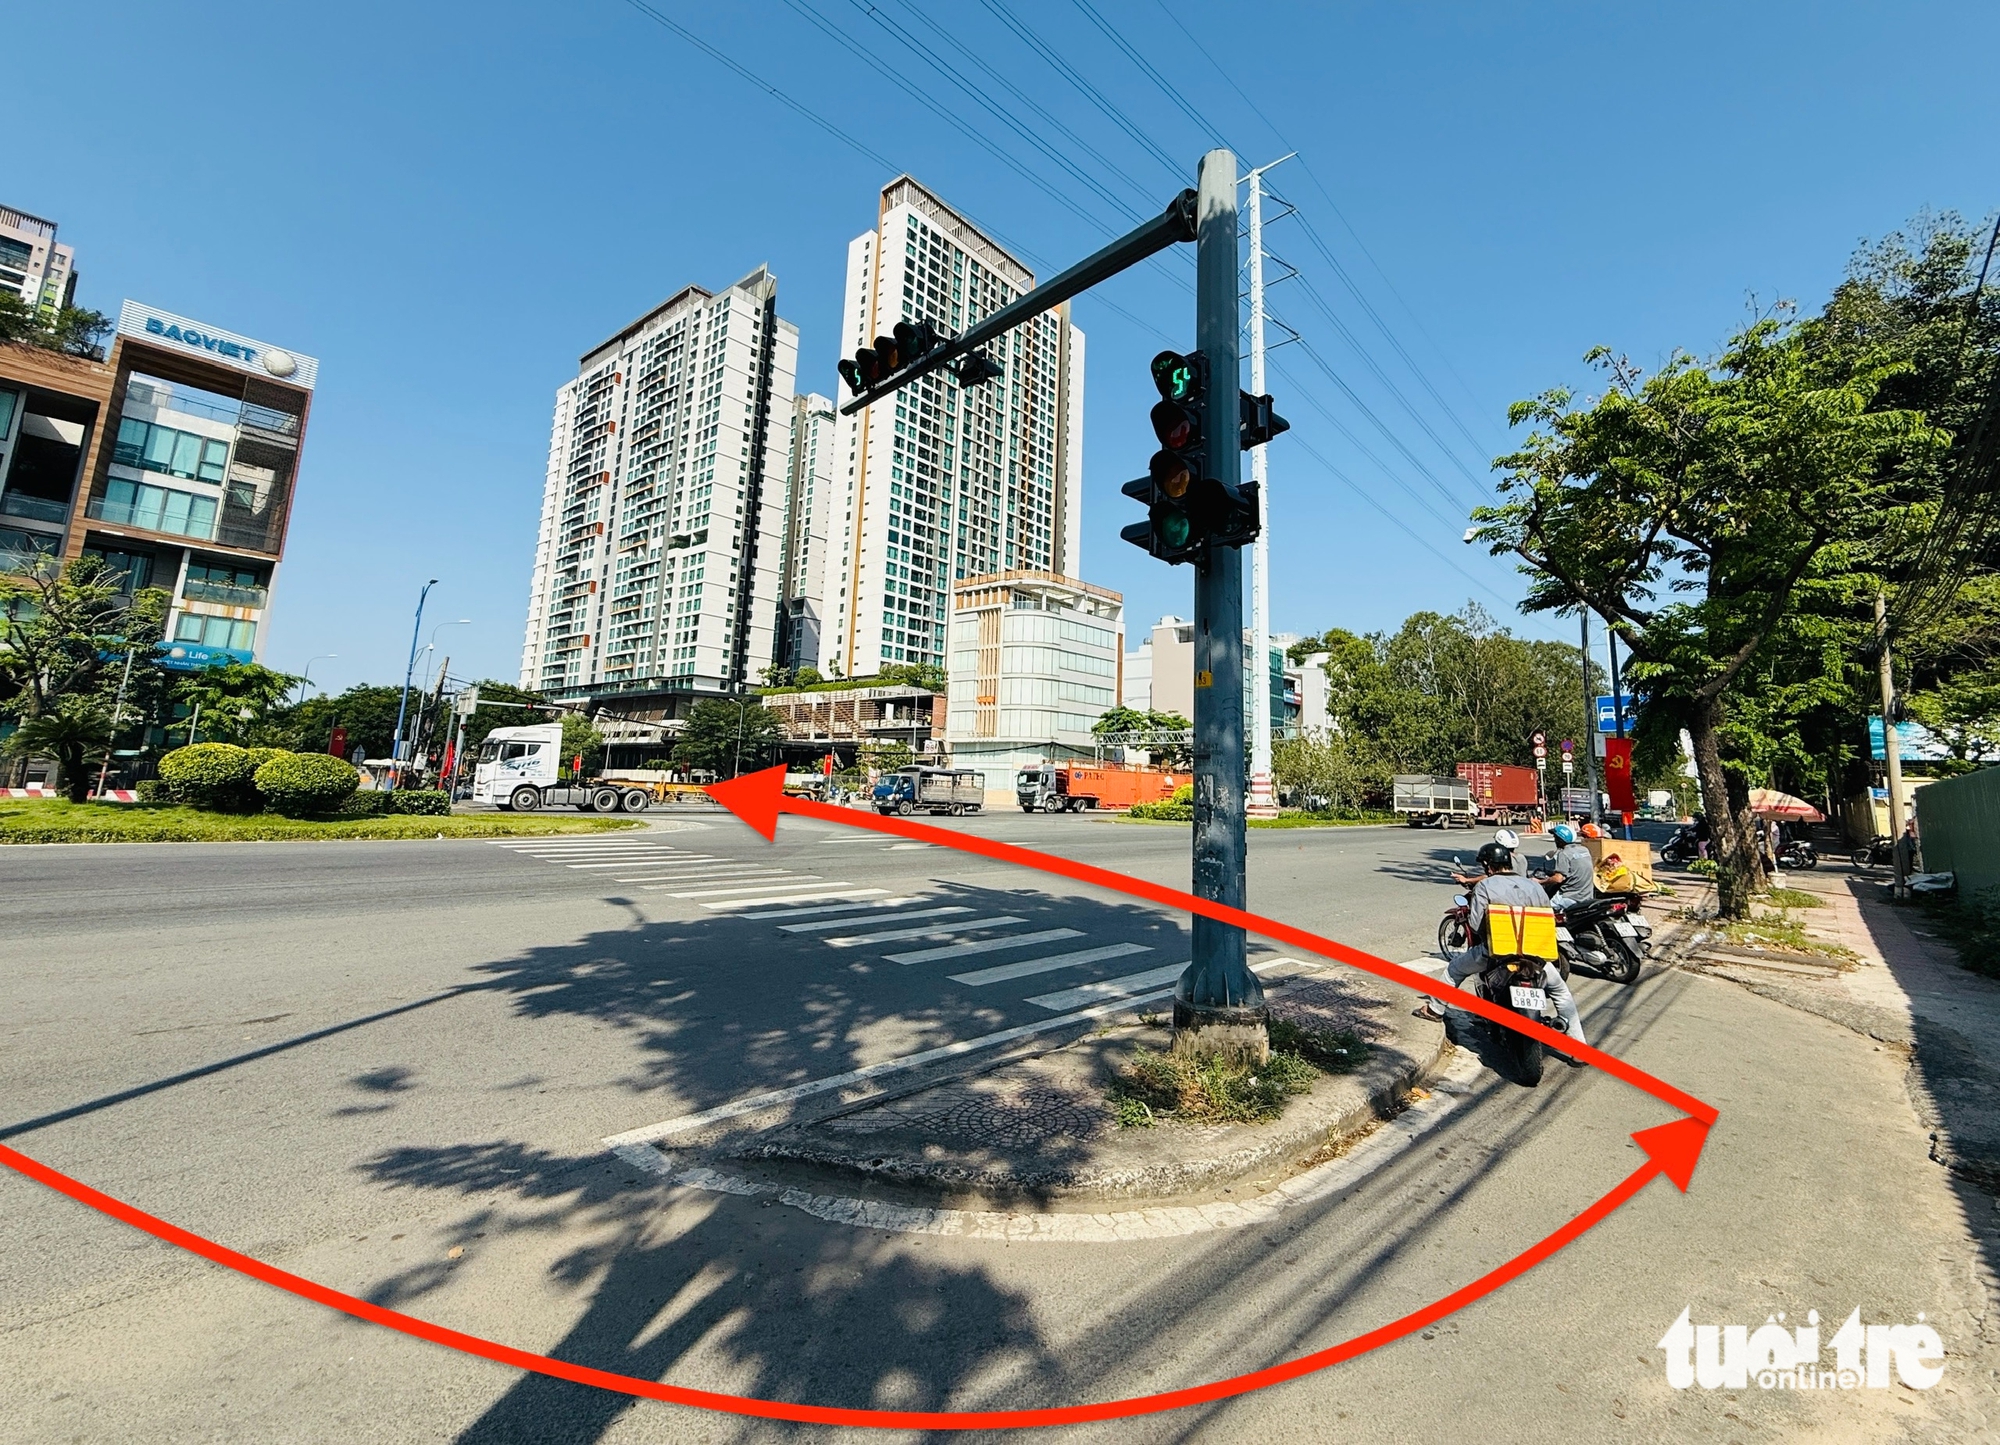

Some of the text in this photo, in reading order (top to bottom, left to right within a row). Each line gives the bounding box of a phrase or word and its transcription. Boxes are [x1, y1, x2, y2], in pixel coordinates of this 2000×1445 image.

[145, 317, 257, 361] BAOVIET
[188, 651, 209, 660] Life
[1513, 996, 1546, 1009] 58873
